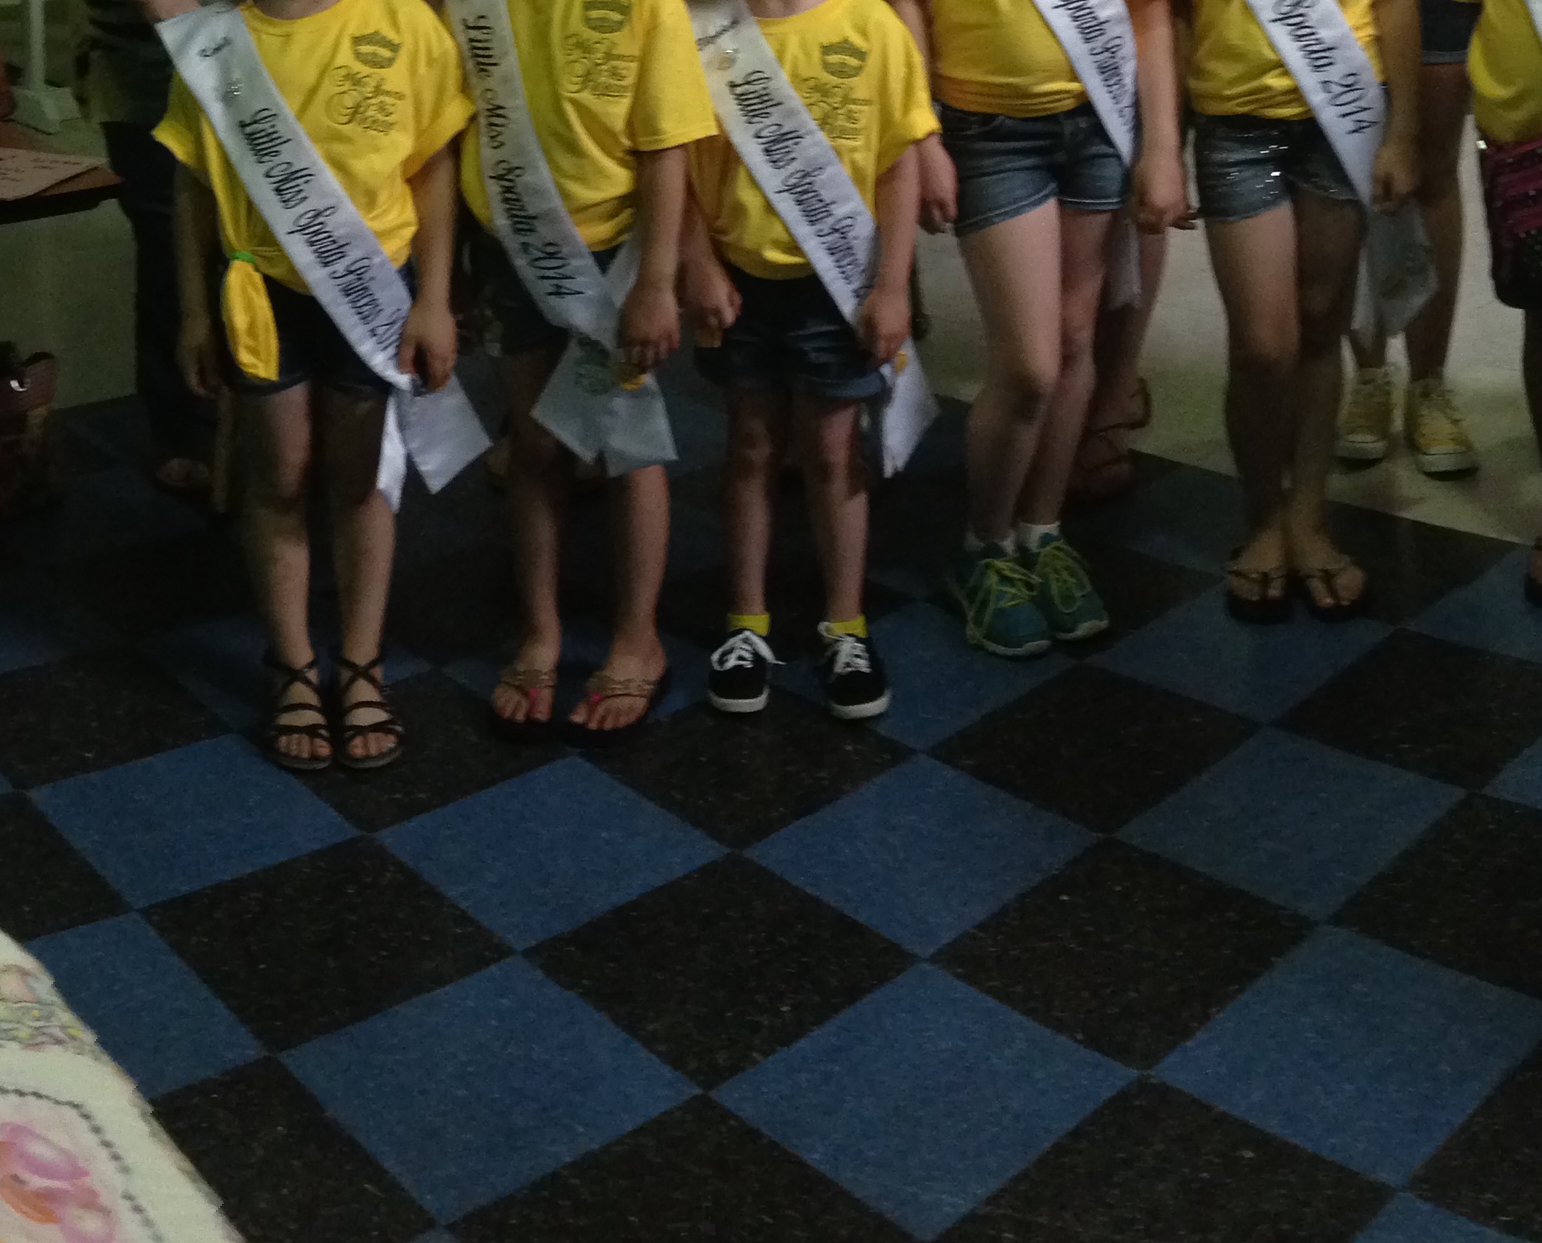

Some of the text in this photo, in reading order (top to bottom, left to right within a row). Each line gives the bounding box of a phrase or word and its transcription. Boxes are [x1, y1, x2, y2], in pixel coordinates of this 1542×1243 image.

[727, 70, 783, 126] Little
[1321, 72, 1383, 135] 2014
[239, 108, 293, 164] Little
[461, 14, 584, 300] Little Miss Sparta 2014
[753, 123, 805, 171] Miss
[264, 161, 315, 211] Miss
[774, 165, 836, 228] Sparta
[287, 206, 347, 268] Sparta
[329, 256, 394, 327] Princess
